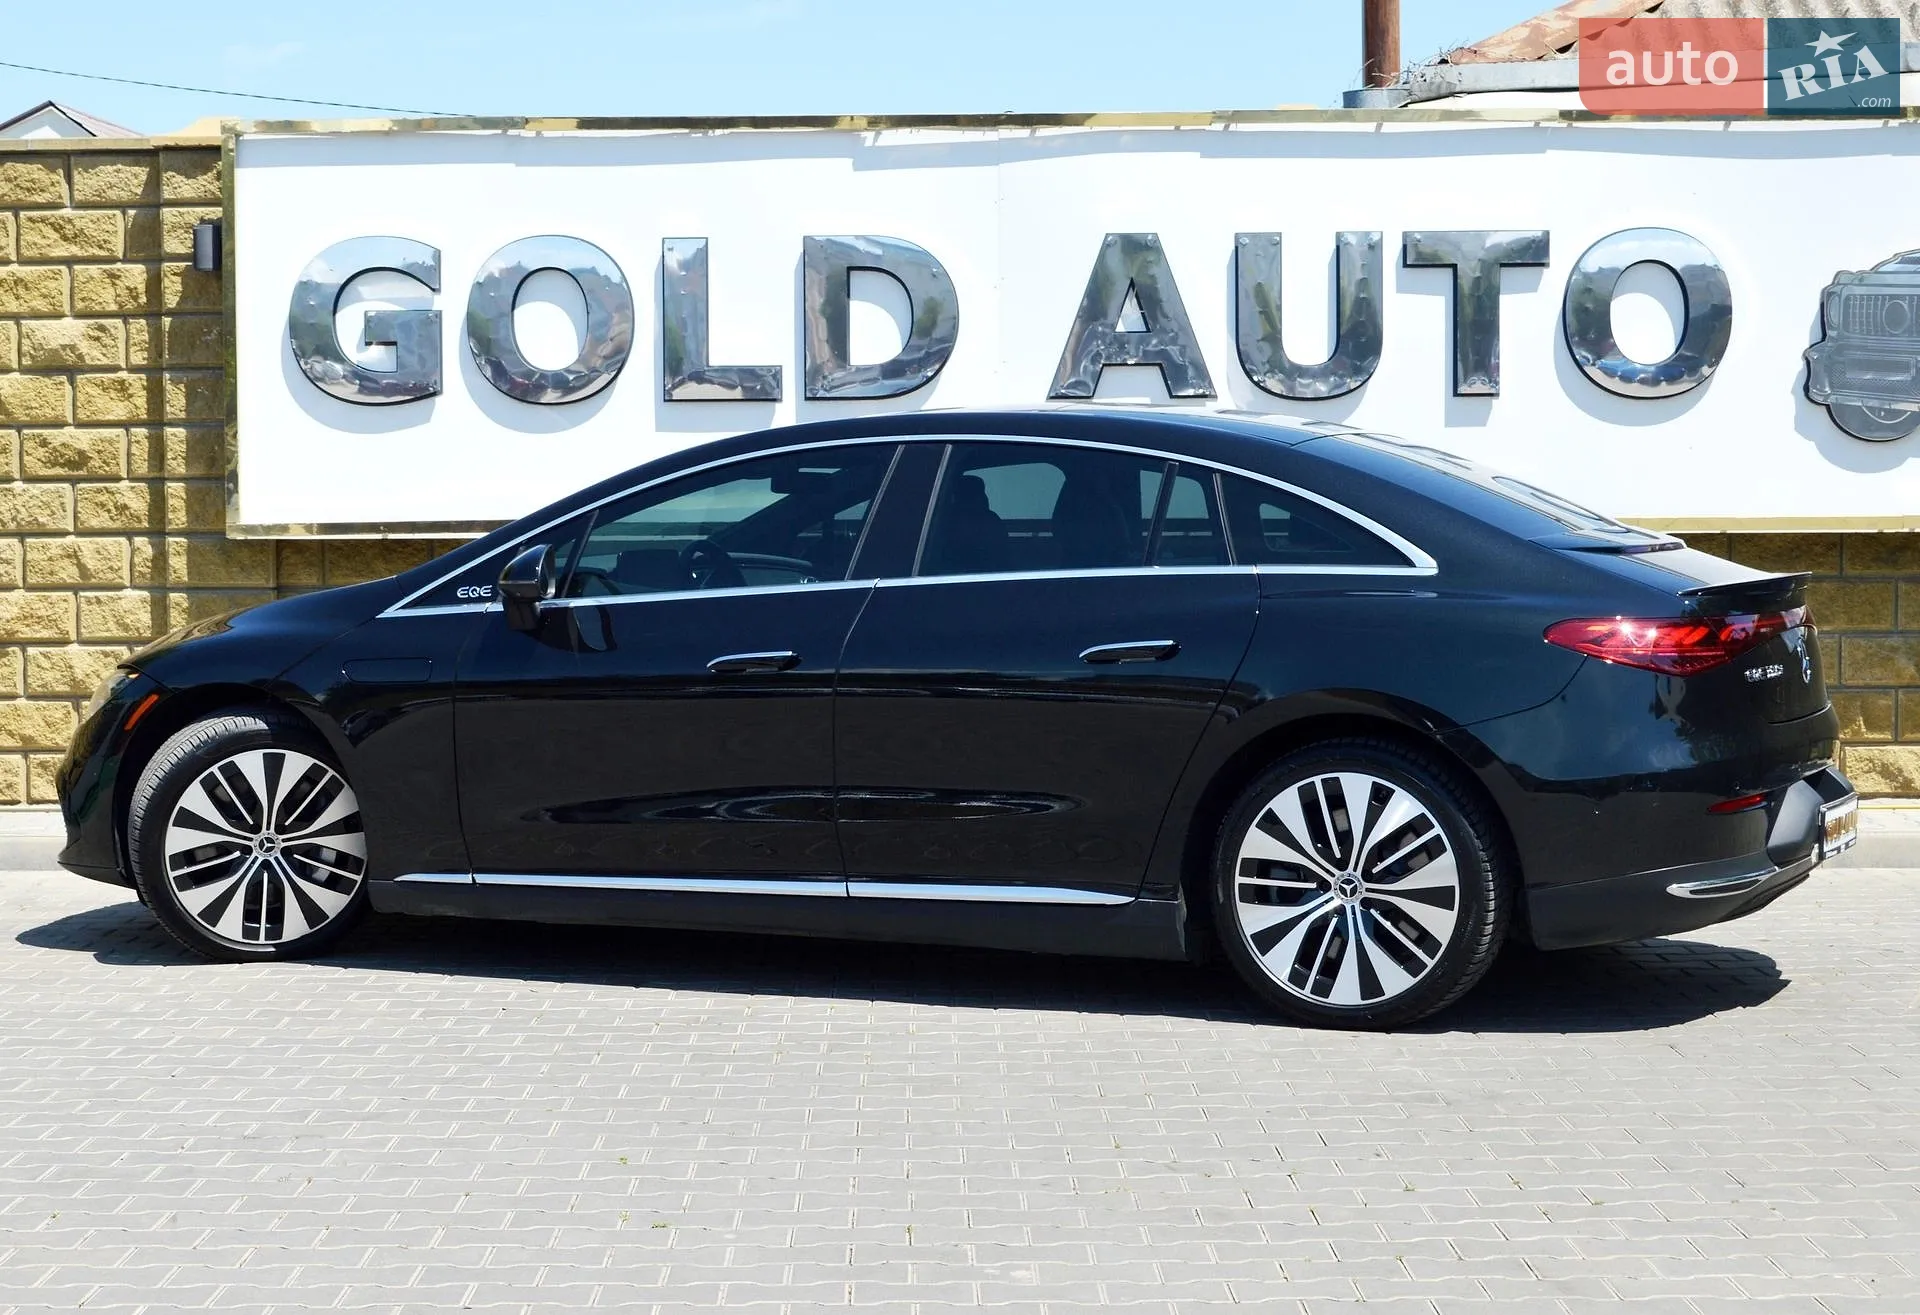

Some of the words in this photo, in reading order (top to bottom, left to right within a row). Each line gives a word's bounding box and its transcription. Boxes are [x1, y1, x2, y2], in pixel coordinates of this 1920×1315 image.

[288, 234, 960, 406] GOLD
[1046, 227, 1734, 401] AUTO
[457, 585, 493, 599] EQE
